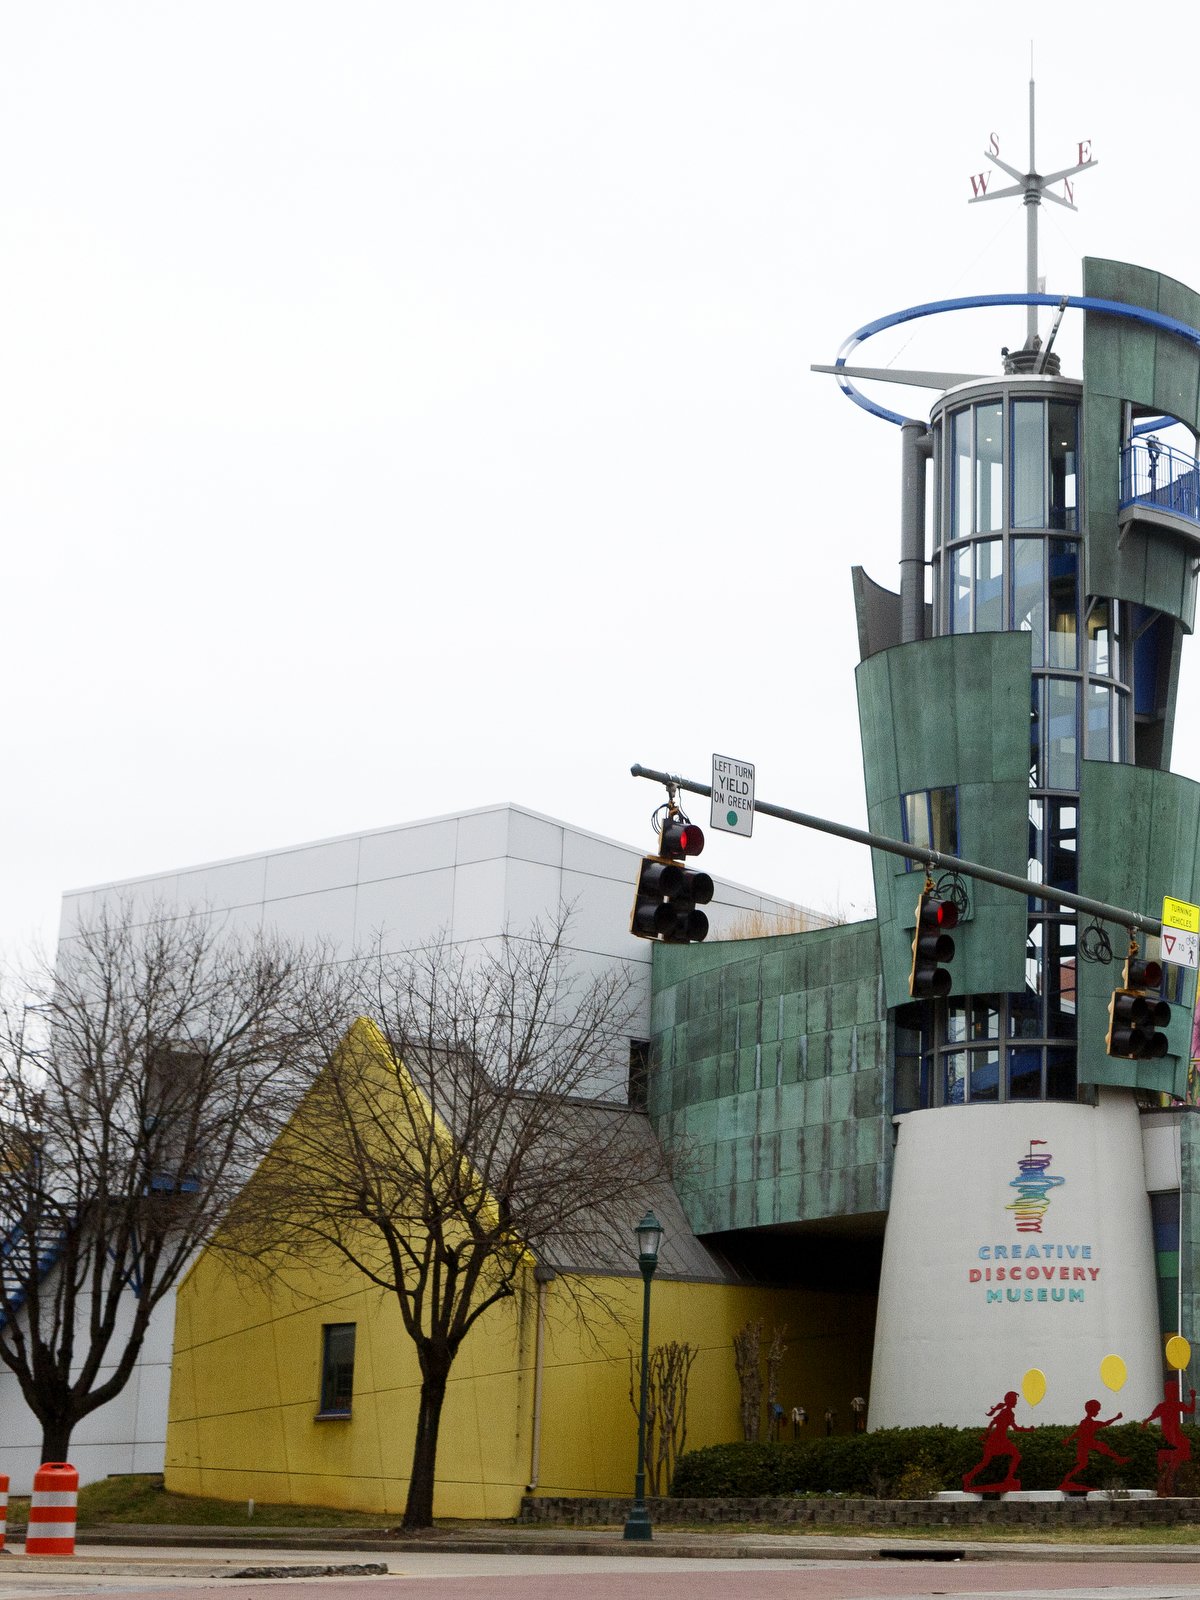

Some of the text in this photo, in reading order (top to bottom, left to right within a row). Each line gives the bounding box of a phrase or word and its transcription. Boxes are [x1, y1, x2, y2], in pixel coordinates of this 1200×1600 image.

[989, 131, 1000, 158] S
[1076, 139, 1092, 167] E
[969, 170, 992, 198] W
[714, 759, 753, 780] LEFT TURN
[718, 775, 749, 796] YIELD
[714, 791, 752, 811] ON GREEN
[1171, 904, 1192, 917] TURNING
[1170, 915, 1192, 928] VEHICLES
[1178, 943, 1185, 952] TO
[978, 1244, 1092, 1260] CREATIVE
[968, 1266, 1100, 1283] DISCOVERY
[986, 1288, 1085, 1303] MUSEUM
